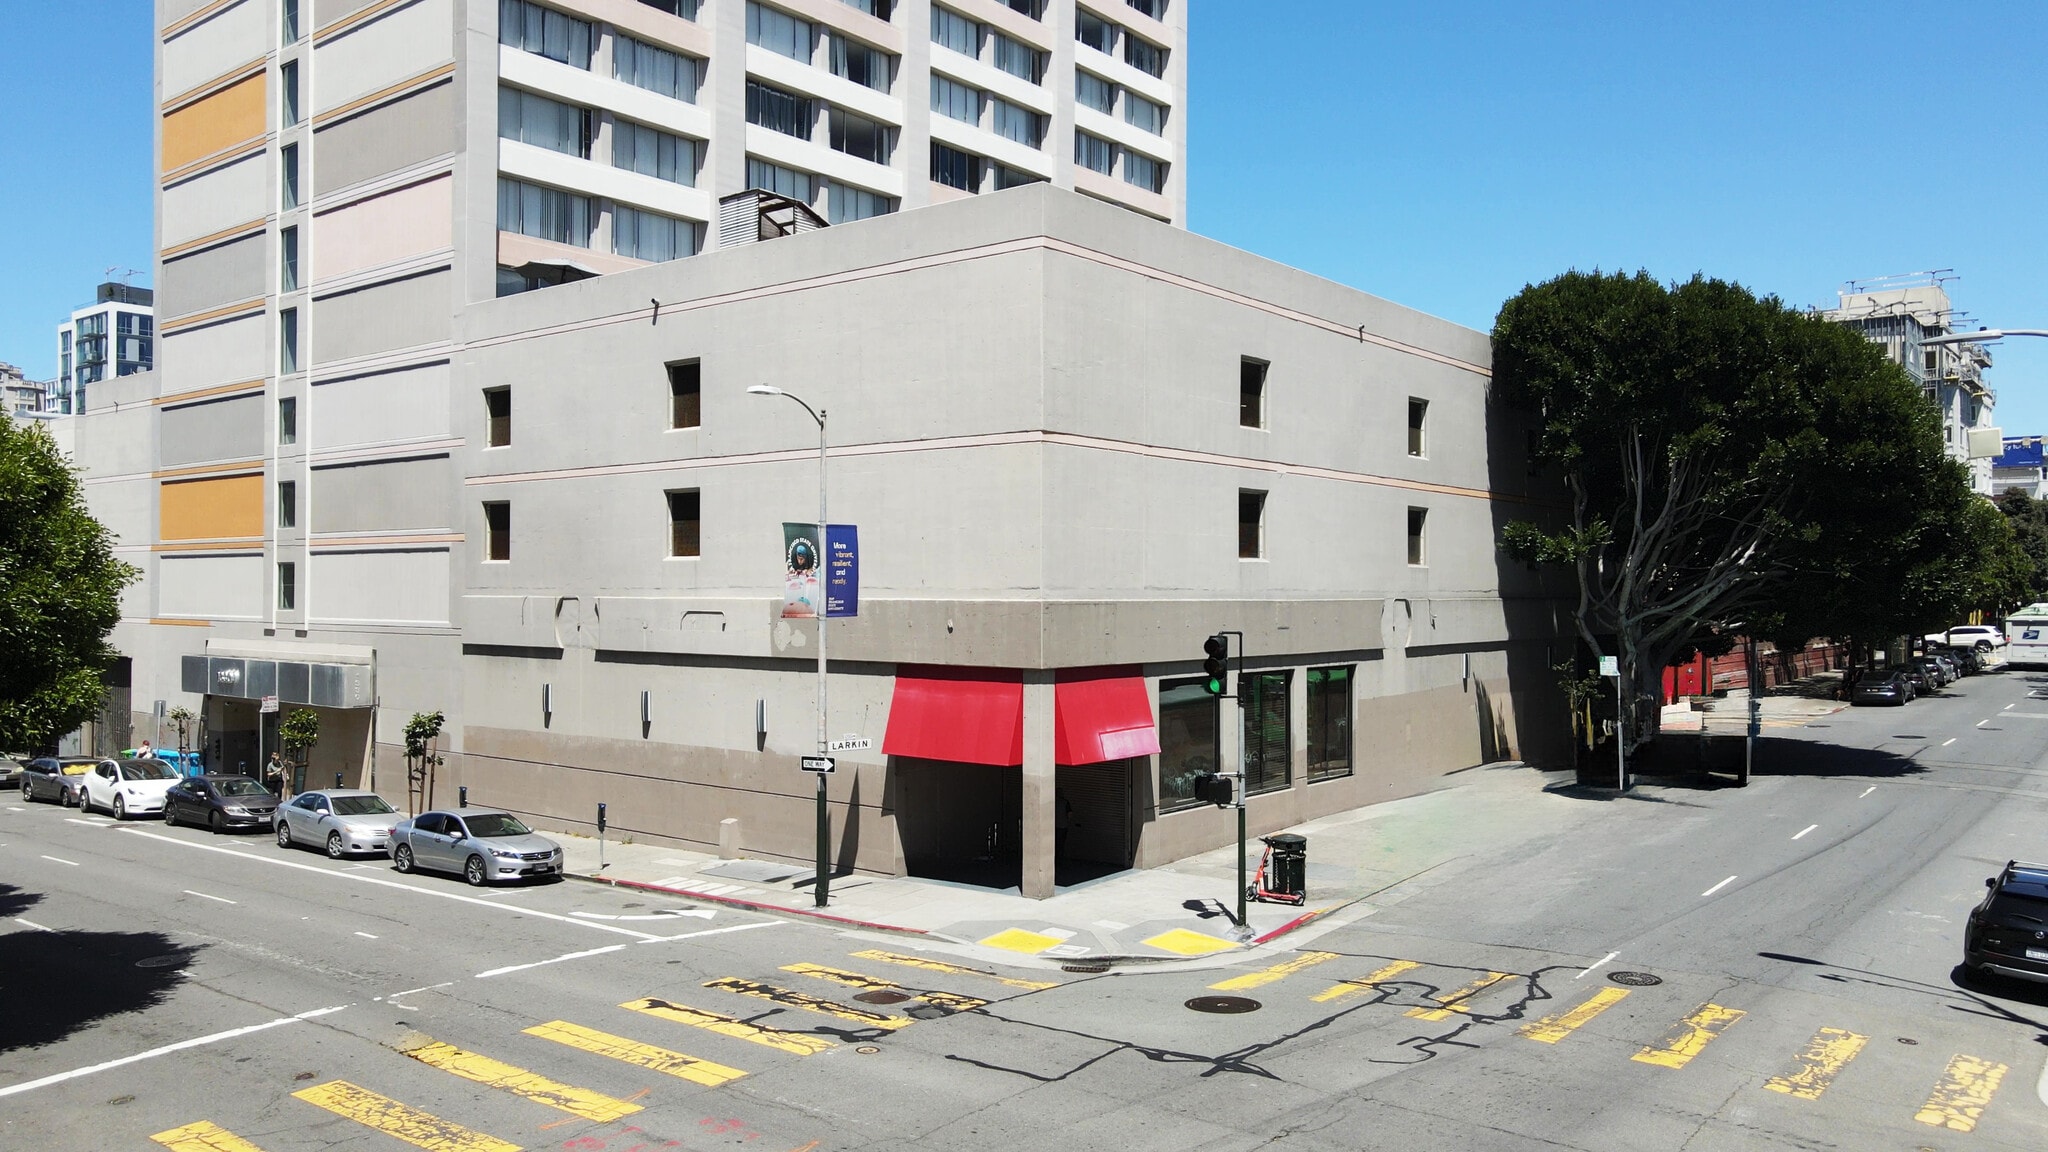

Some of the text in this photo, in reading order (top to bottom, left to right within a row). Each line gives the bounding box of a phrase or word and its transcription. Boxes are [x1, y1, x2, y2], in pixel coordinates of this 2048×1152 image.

[833, 542, 847, 550] More
[835, 568, 846, 576] and
[832, 740, 868, 750] LARKIN
